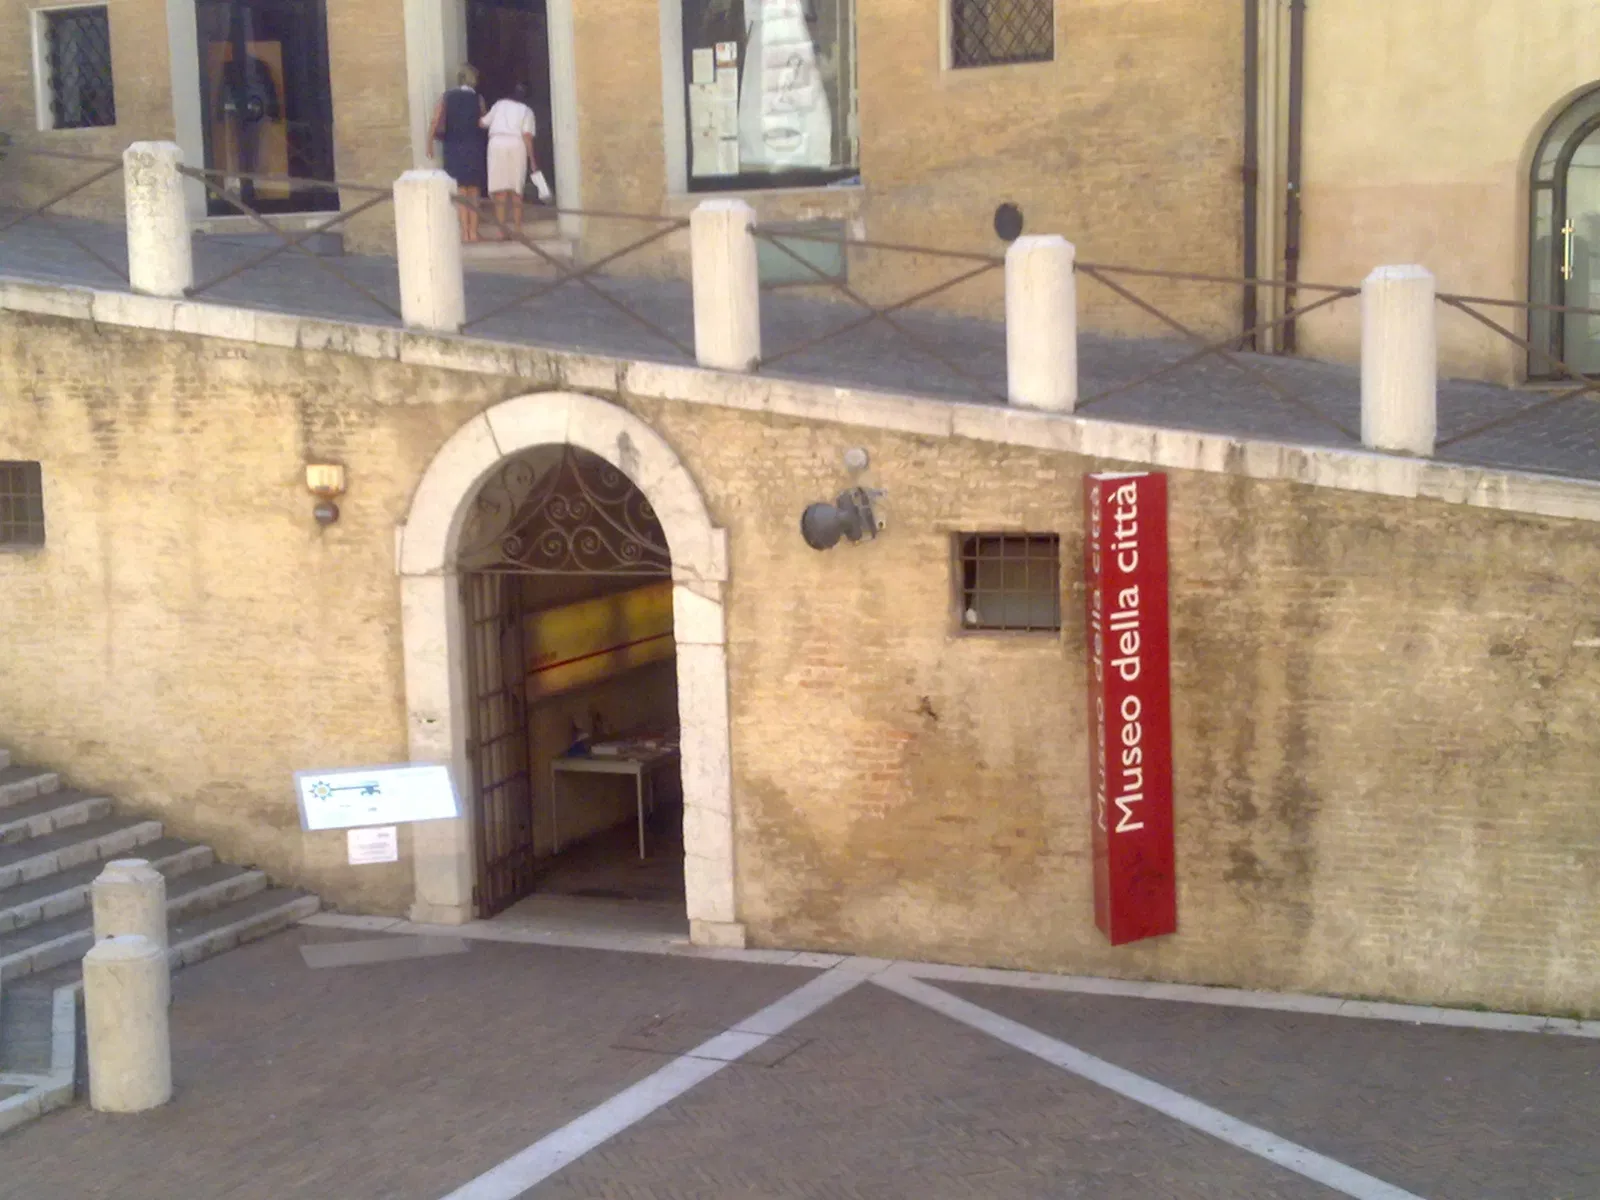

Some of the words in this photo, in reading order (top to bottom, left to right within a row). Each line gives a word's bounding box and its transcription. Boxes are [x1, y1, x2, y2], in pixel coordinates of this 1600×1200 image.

[1107, 480, 1139, 573] città
[1110, 584, 1142, 682] della
[1114, 695, 1145, 833] Museo
